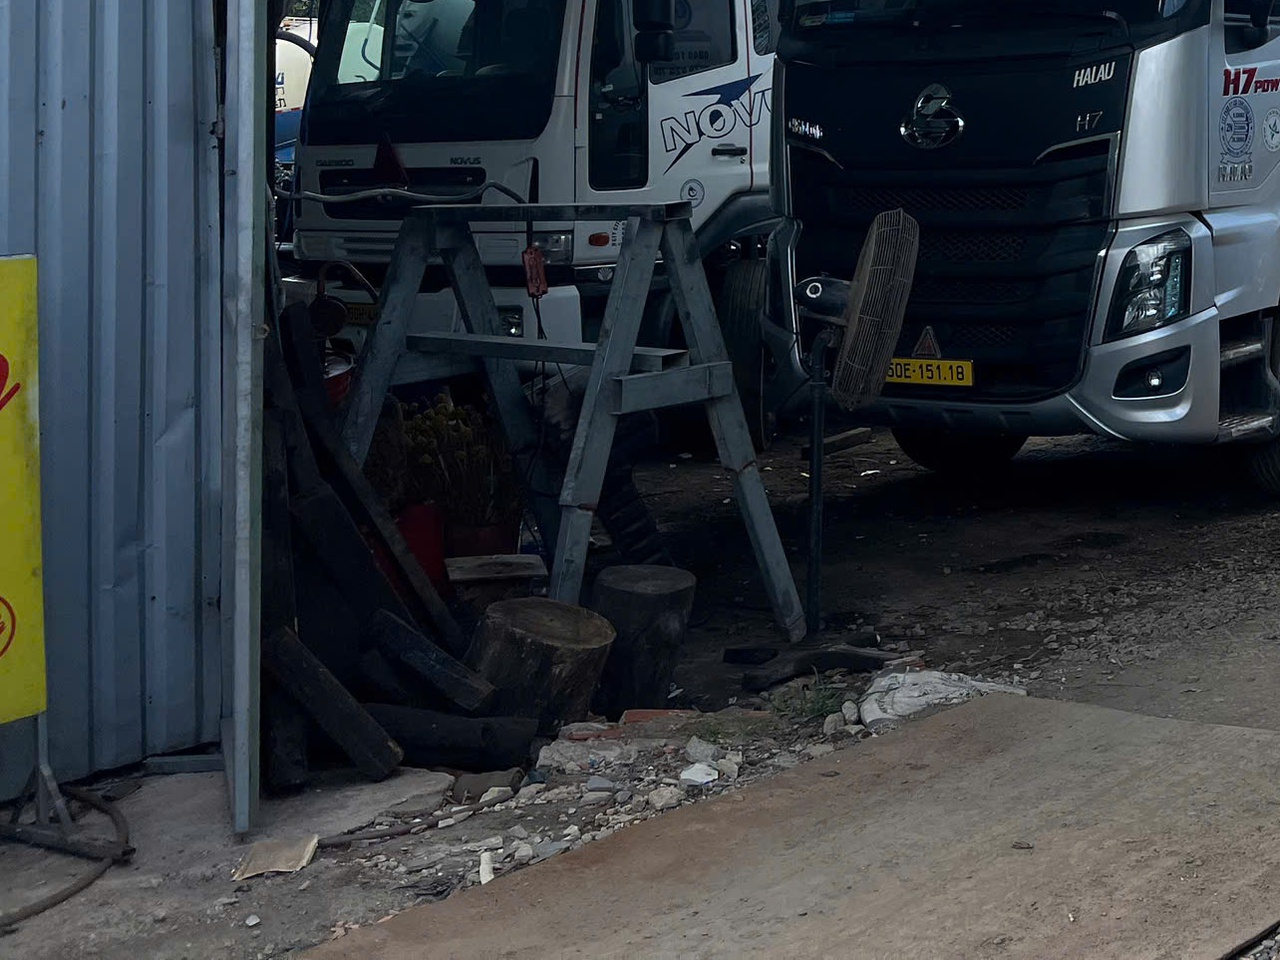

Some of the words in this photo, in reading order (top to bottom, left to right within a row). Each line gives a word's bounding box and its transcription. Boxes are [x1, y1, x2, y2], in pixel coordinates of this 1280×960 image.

[1222, 67, 1258, 96] H7
[1076, 111, 1103, 132] H7
[449, 156, 481, 165] NOVUS
